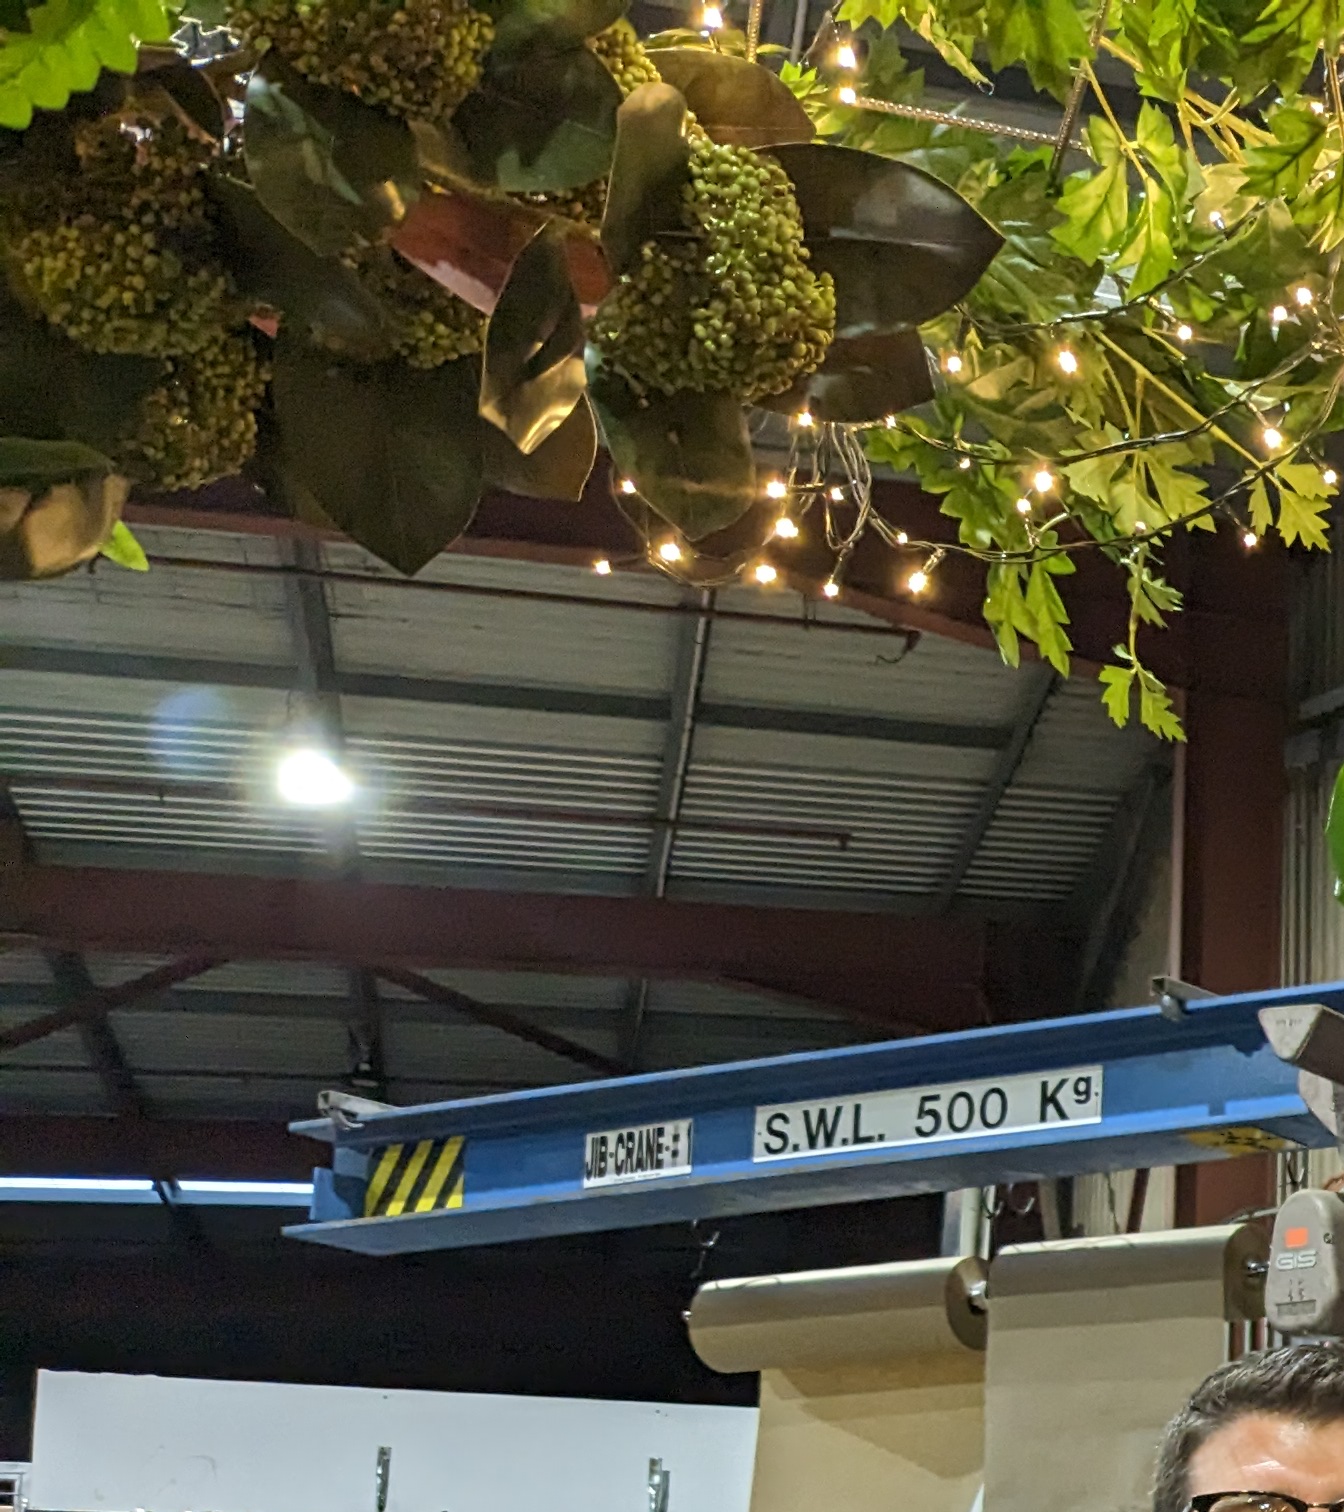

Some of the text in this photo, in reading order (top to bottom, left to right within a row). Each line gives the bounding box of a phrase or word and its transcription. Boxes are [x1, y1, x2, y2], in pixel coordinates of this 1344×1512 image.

[763, 1102, 886, 1155] S.W.L.
[914, 1087, 1008, 1138] 500
[1275, 1249, 1318, 1272] GIS
